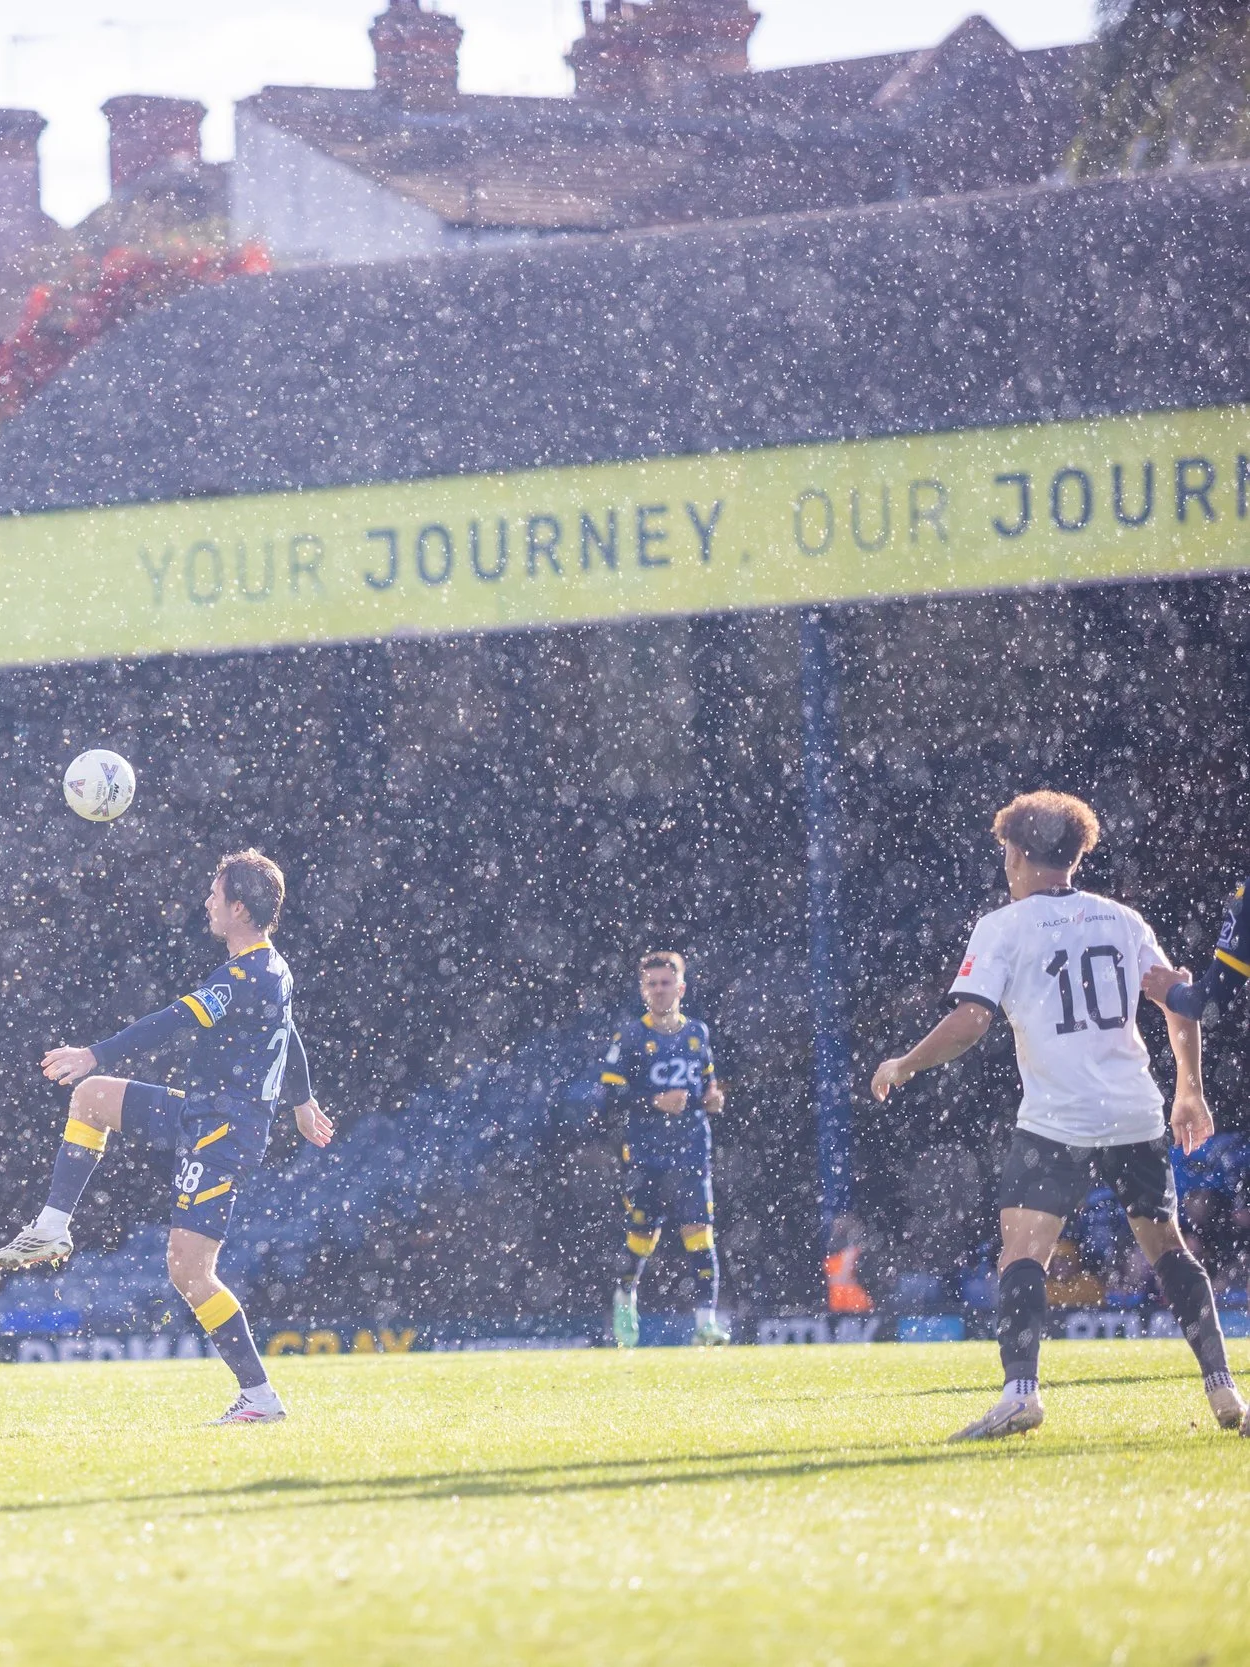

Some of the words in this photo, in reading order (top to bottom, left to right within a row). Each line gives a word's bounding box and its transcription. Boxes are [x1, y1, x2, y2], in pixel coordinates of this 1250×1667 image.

[136, 535, 326, 606] YOUR
[793, 479, 949, 558] OUR
[1085, 914, 1116, 923] GREEN
[1046, 945, 1128, 1035] 10
[261, 1028, 288, 1100] 2
